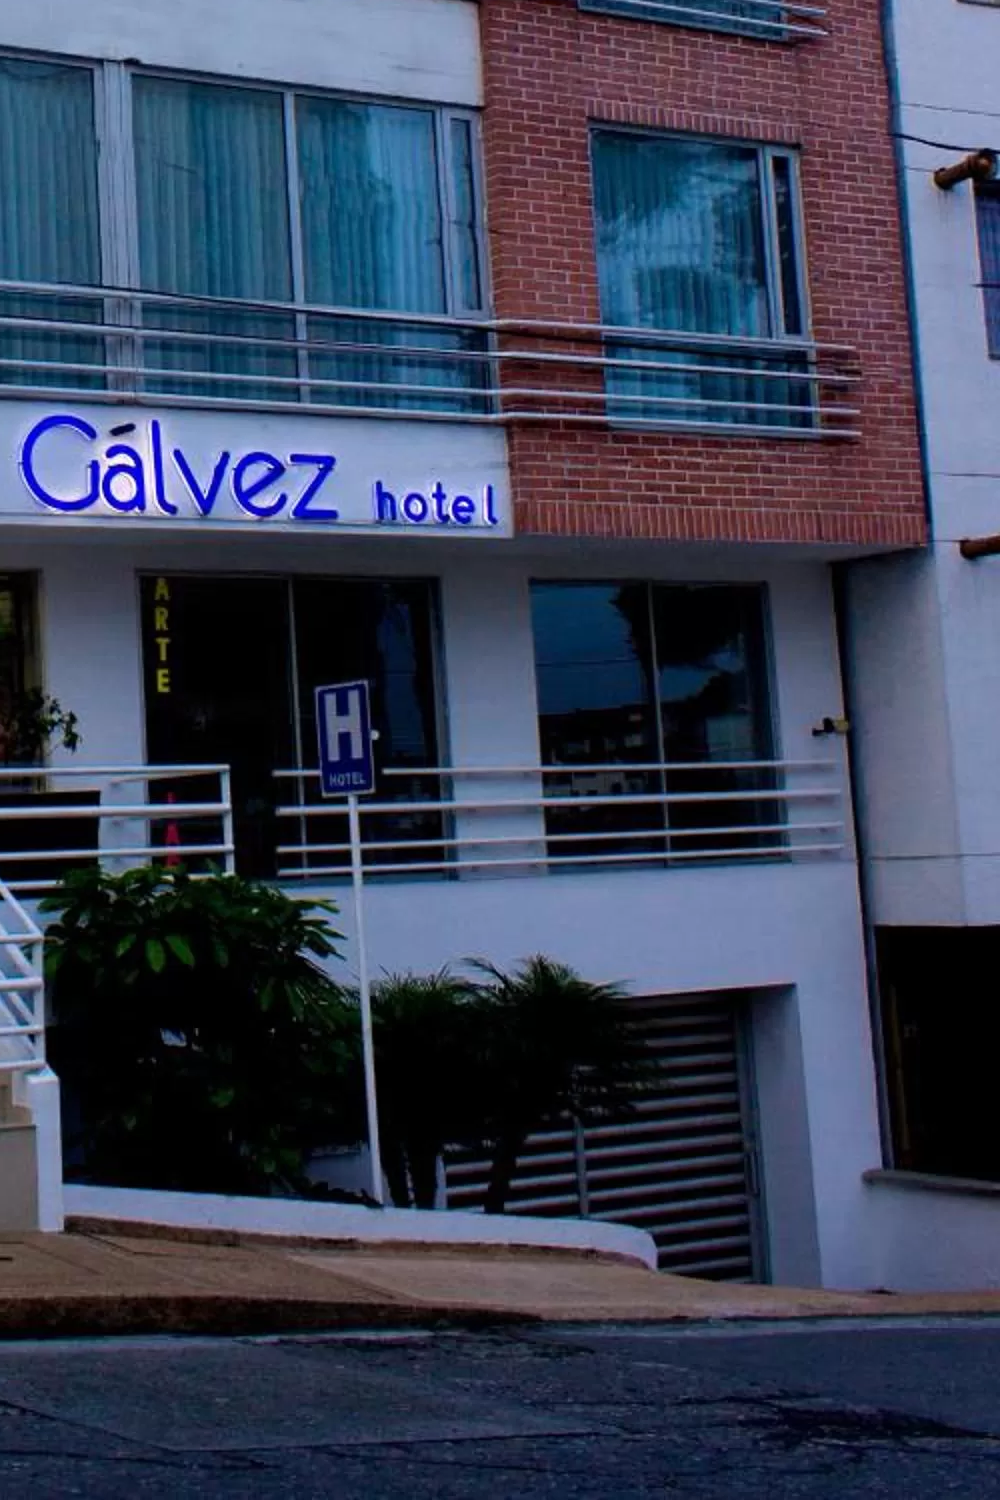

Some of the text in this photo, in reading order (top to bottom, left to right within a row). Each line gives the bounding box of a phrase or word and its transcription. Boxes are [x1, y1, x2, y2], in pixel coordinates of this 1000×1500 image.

[20, 414, 339, 520] Gálvez
[373, 480, 498, 526] hotel
[155, 577, 171, 693] ARTE
[323, 689, 364, 762] H
[329, 771, 366, 787] HOTEL
